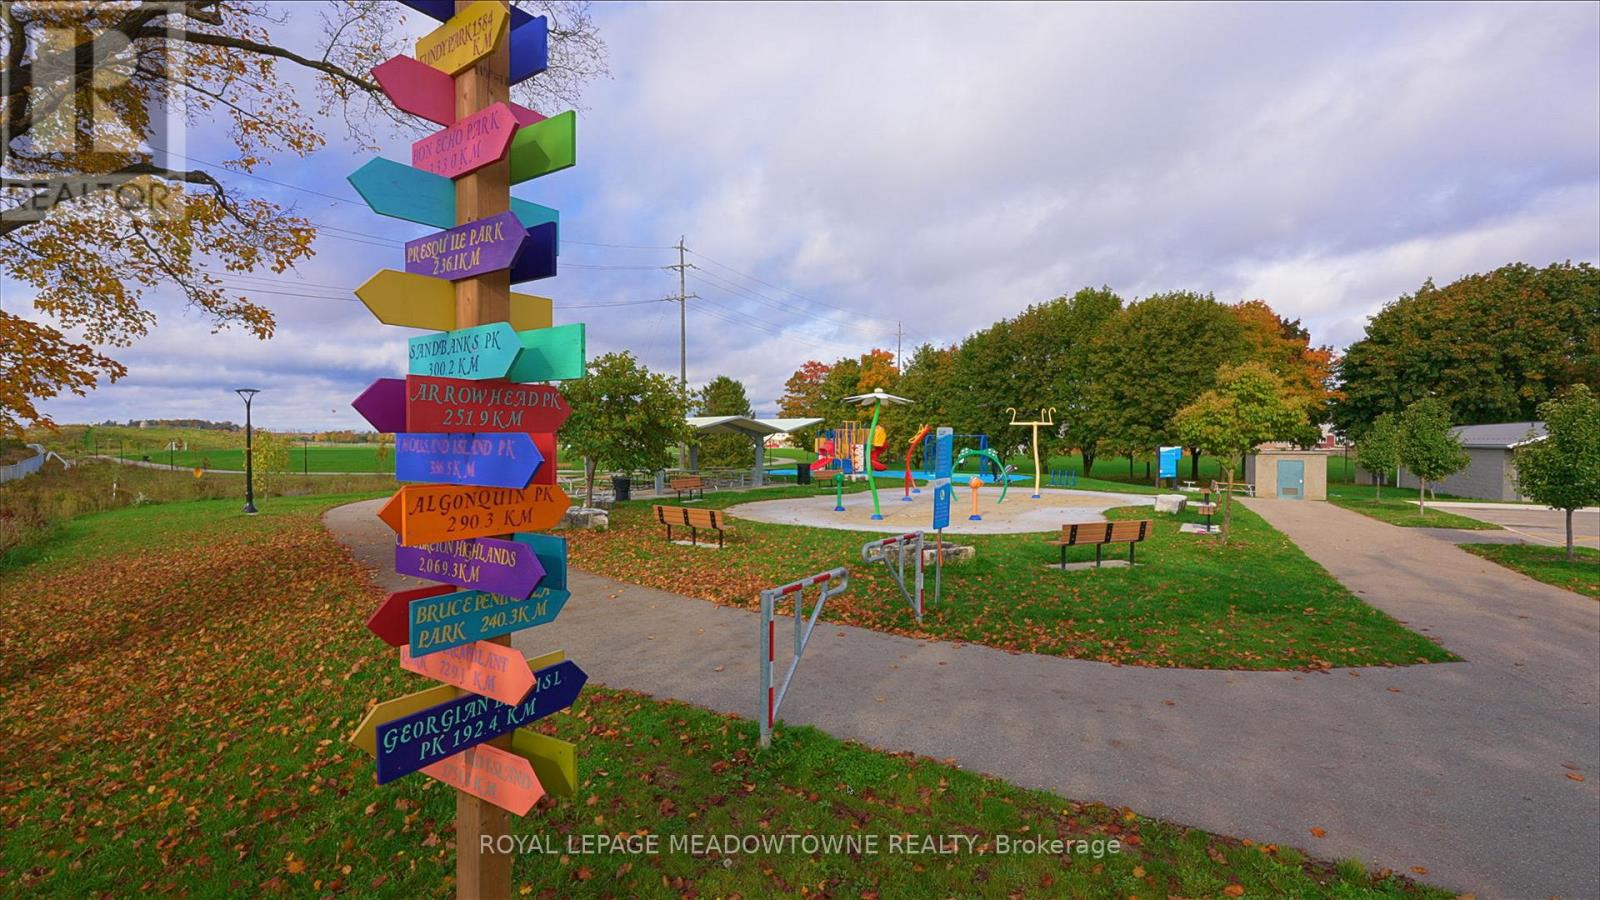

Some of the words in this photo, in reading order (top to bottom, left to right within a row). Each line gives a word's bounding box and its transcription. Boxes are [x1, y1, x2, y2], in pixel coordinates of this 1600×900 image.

[466, 111, 500, 140] PARK
[469, 221, 504, 246] PARK
[408, 334, 480, 360] SANDBANKS
[484, 330, 502, 352] PK
[410, 383, 539, 407] ARROWHEAD
[541, 393, 563, 410] PK
[497, 439, 516, 459] PK
[409, 489, 525, 516] ALGONQUIN
[535, 486, 554, 503] PK
[504, 507, 533, 527] KM
[453, 540, 517, 568] HIGHLANDS
[416, 596, 473, 625] BRUCE
[418, 621, 467, 649] PARK
[383, 696, 490, 755] GEORGIAN
[535, 670, 563, 693] ISL
[418, 732, 446, 761] PK
[506, 698, 537, 726] KM
